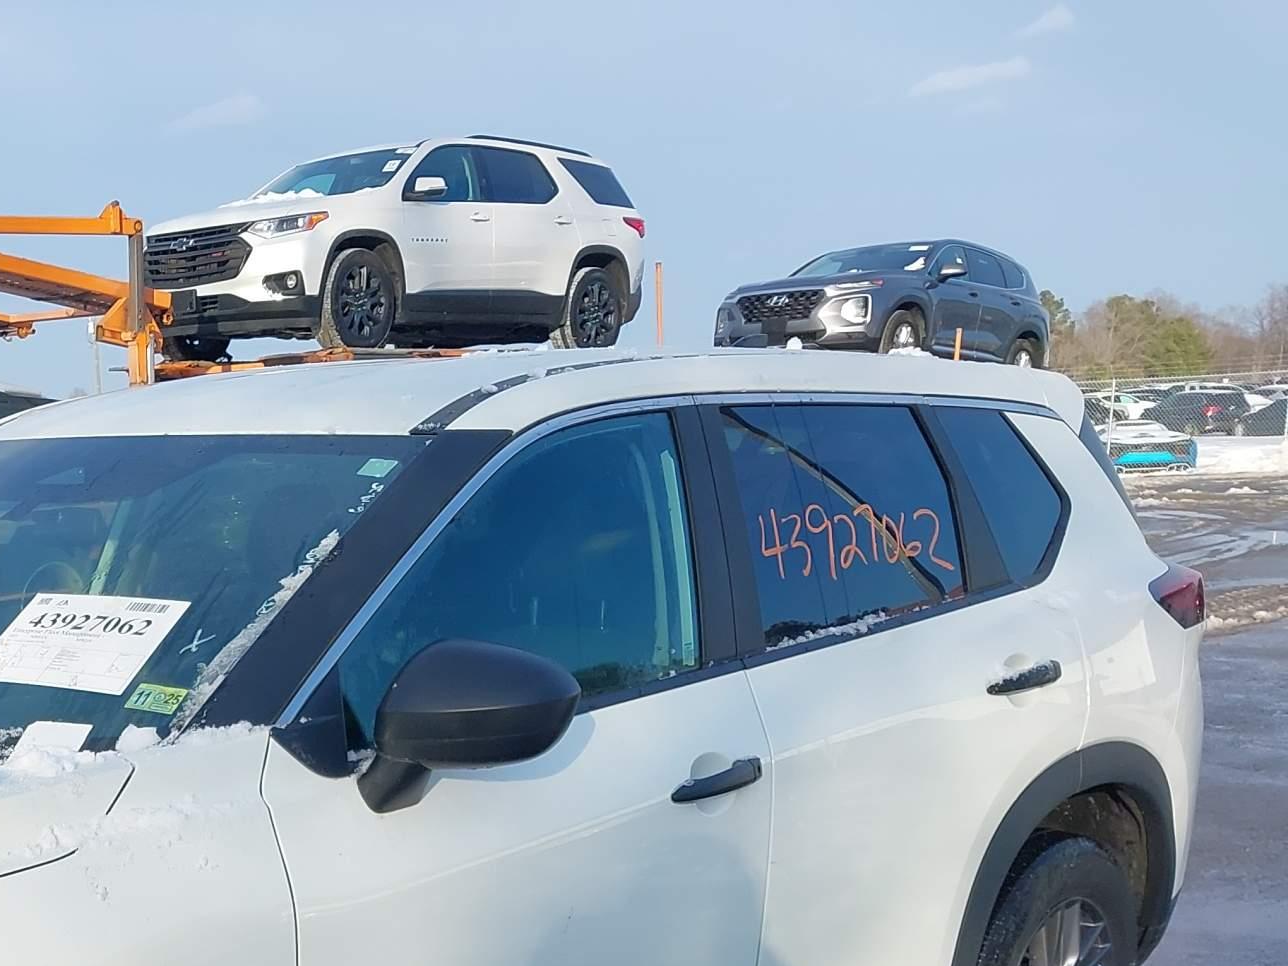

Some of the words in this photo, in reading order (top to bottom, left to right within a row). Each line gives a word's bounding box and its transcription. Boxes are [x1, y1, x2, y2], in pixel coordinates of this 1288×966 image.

[758, 504, 955, 580] 43927062
[29, 612, 153, 636] 43927062
[134, 690, 152, 705] 11
[163, 693, 183, 705] 25
